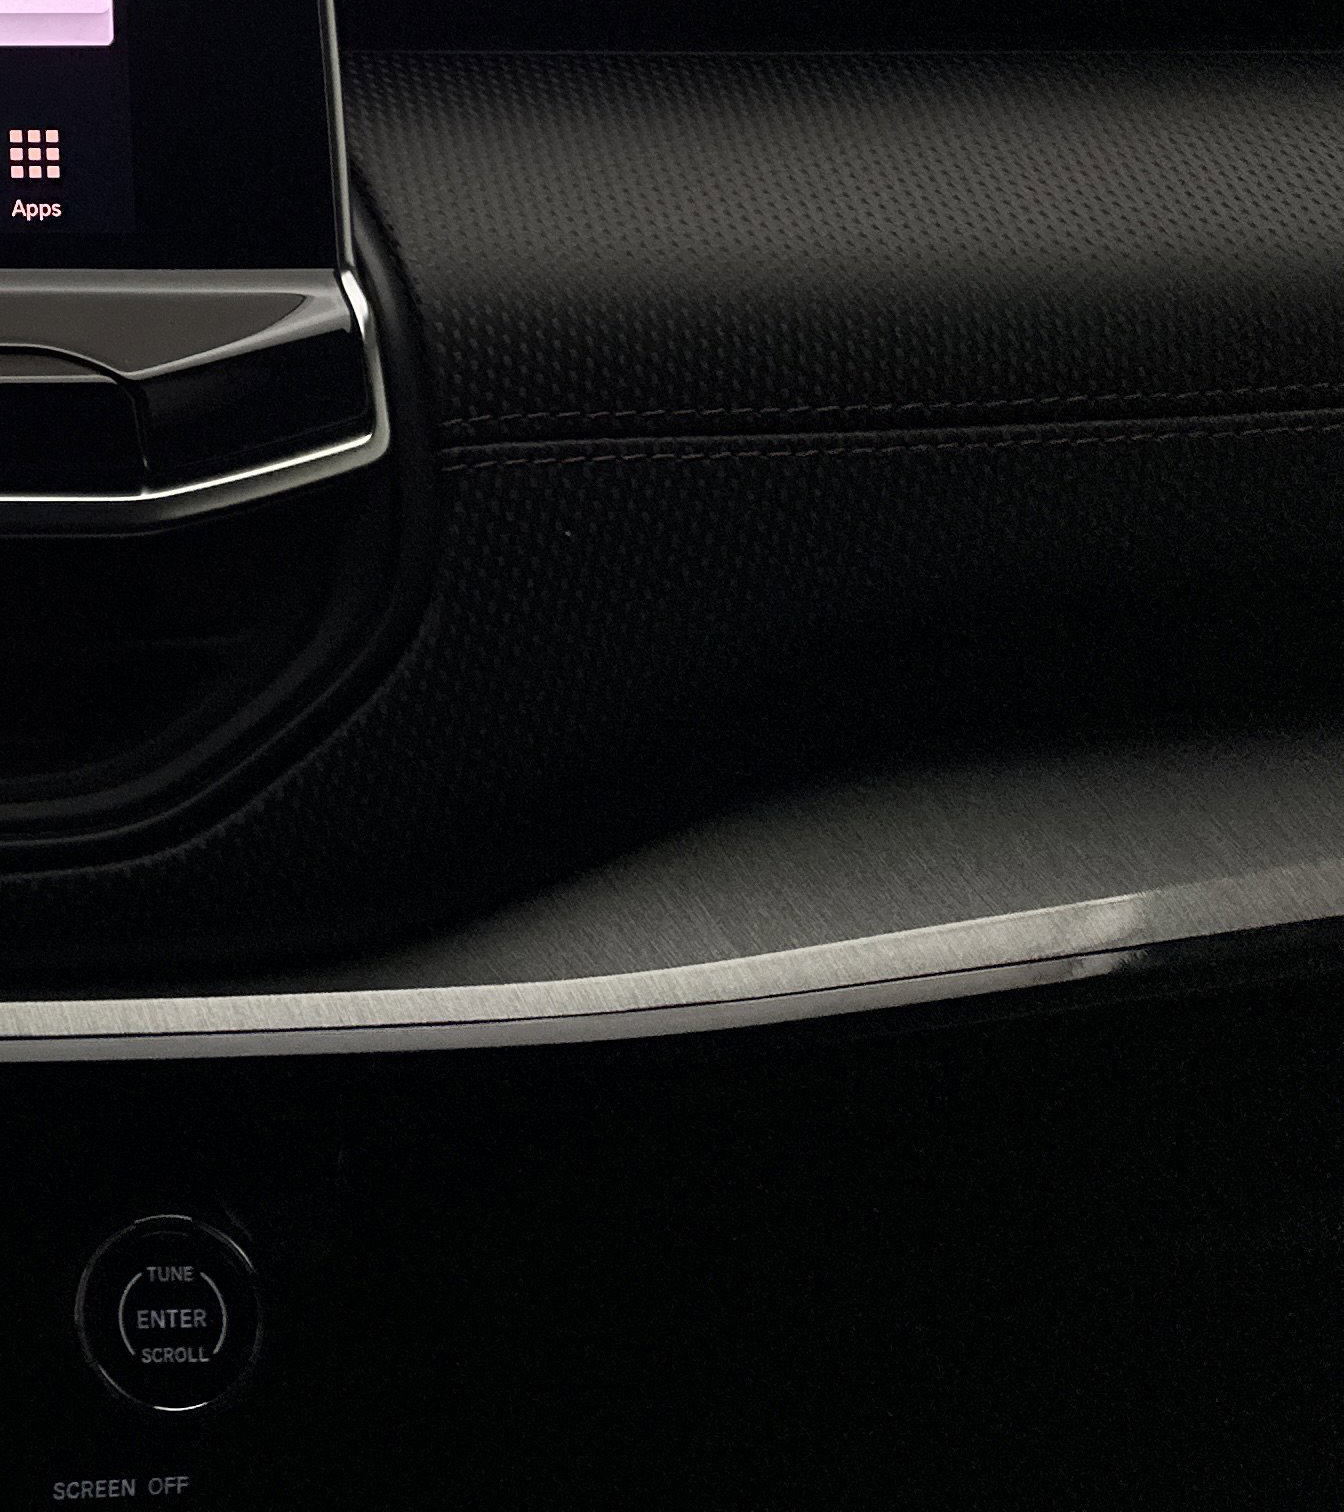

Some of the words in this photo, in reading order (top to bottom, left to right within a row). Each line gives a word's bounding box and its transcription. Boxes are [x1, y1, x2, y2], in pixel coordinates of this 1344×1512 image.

[11, 198, 62, 222] Apps
[146, 1265, 194, 1282] TUNE
[137, 1308, 207, 1329] ENTER
[141, 1346, 210, 1364] SCROLL
[53, 1478, 136, 1501] SCREEN
[148, 1475, 189, 1496] OFF
